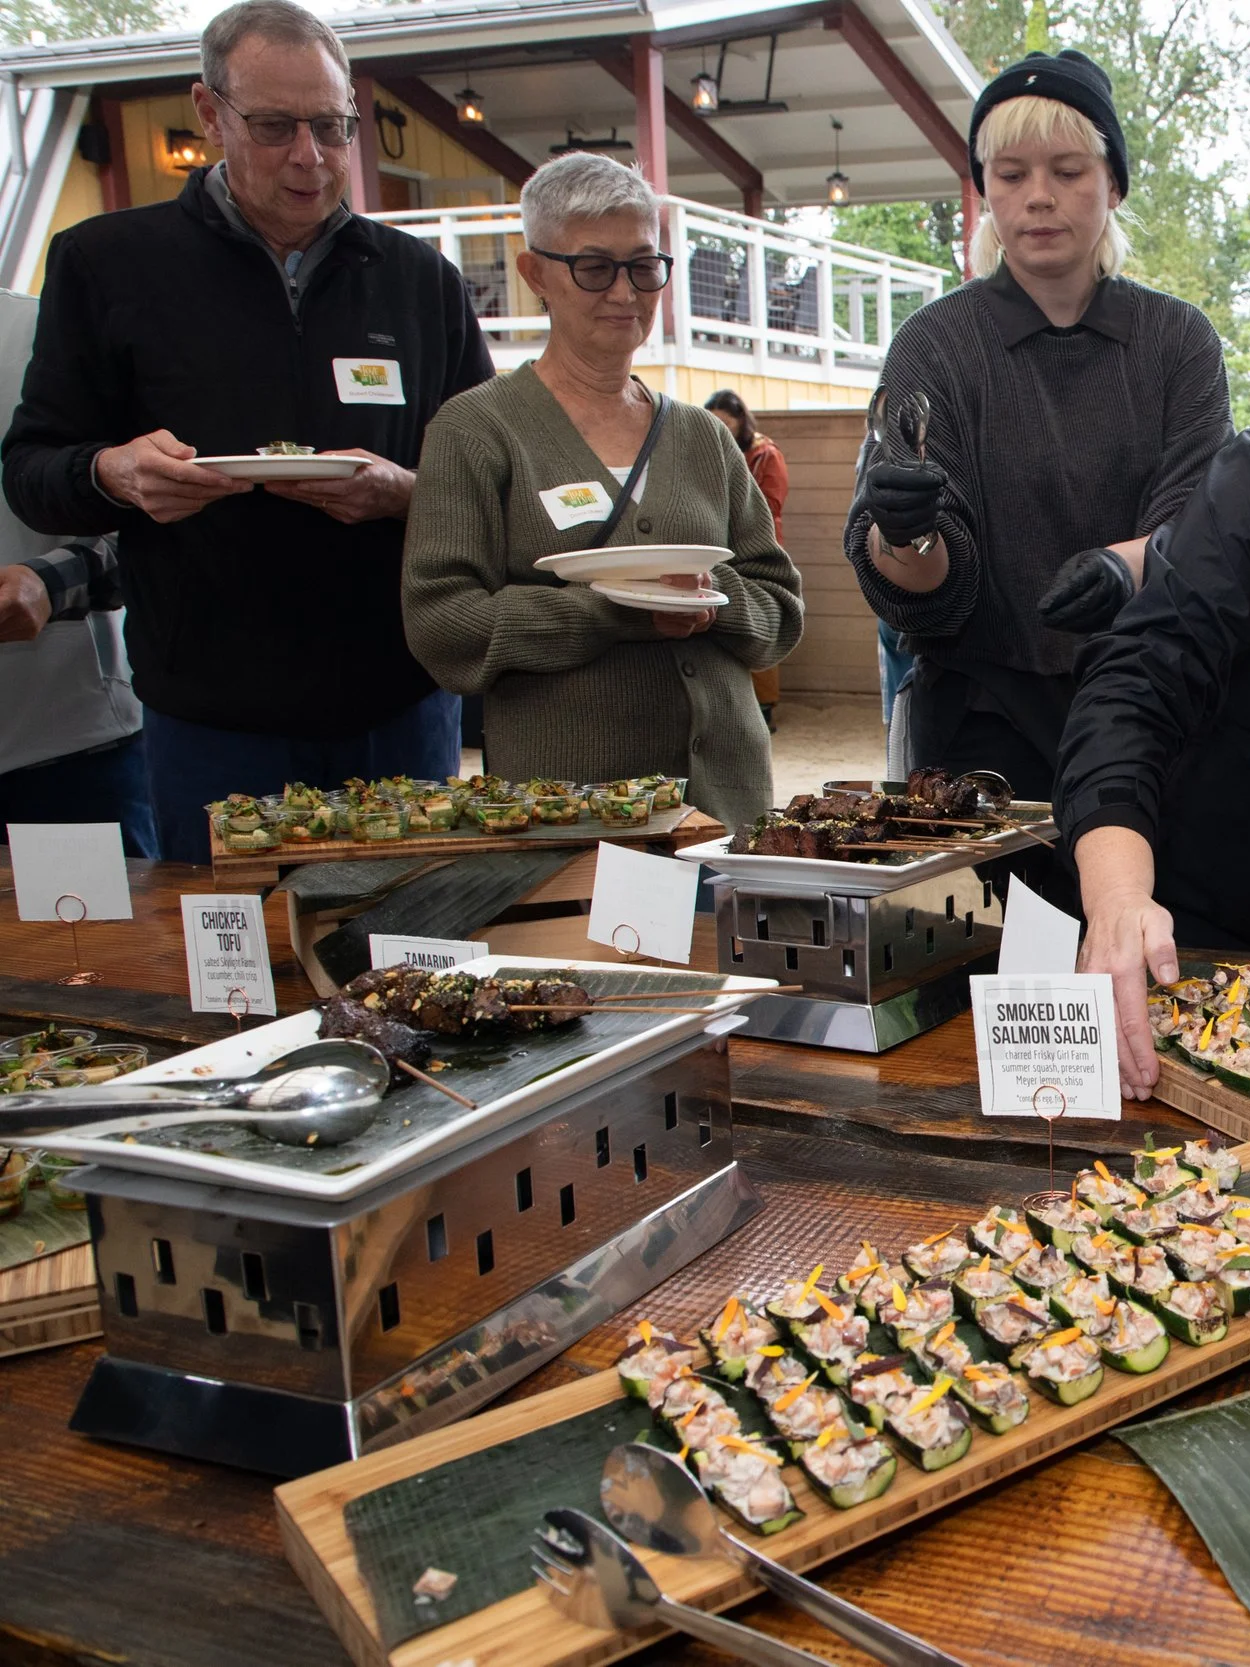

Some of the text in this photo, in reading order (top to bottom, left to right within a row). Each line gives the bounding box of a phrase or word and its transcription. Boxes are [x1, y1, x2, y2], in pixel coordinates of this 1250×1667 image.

[201, 911, 248, 930] CHICKPEA
[217, 933, 242, 951] TOFU
[404, 952, 456, 969] TAMARIND
[996, 1003, 1090, 1021] SMOKED LOKI
[992, 1025, 1098, 1044] SALMON SALAD
[1004, 1049, 1089, 1062] charred Frisky Girl Farm
[1001, 1063, 1096, 1075] summer squash, preserved
[1015, 1075, 1084, 1087] Meyer lemon, shiso
